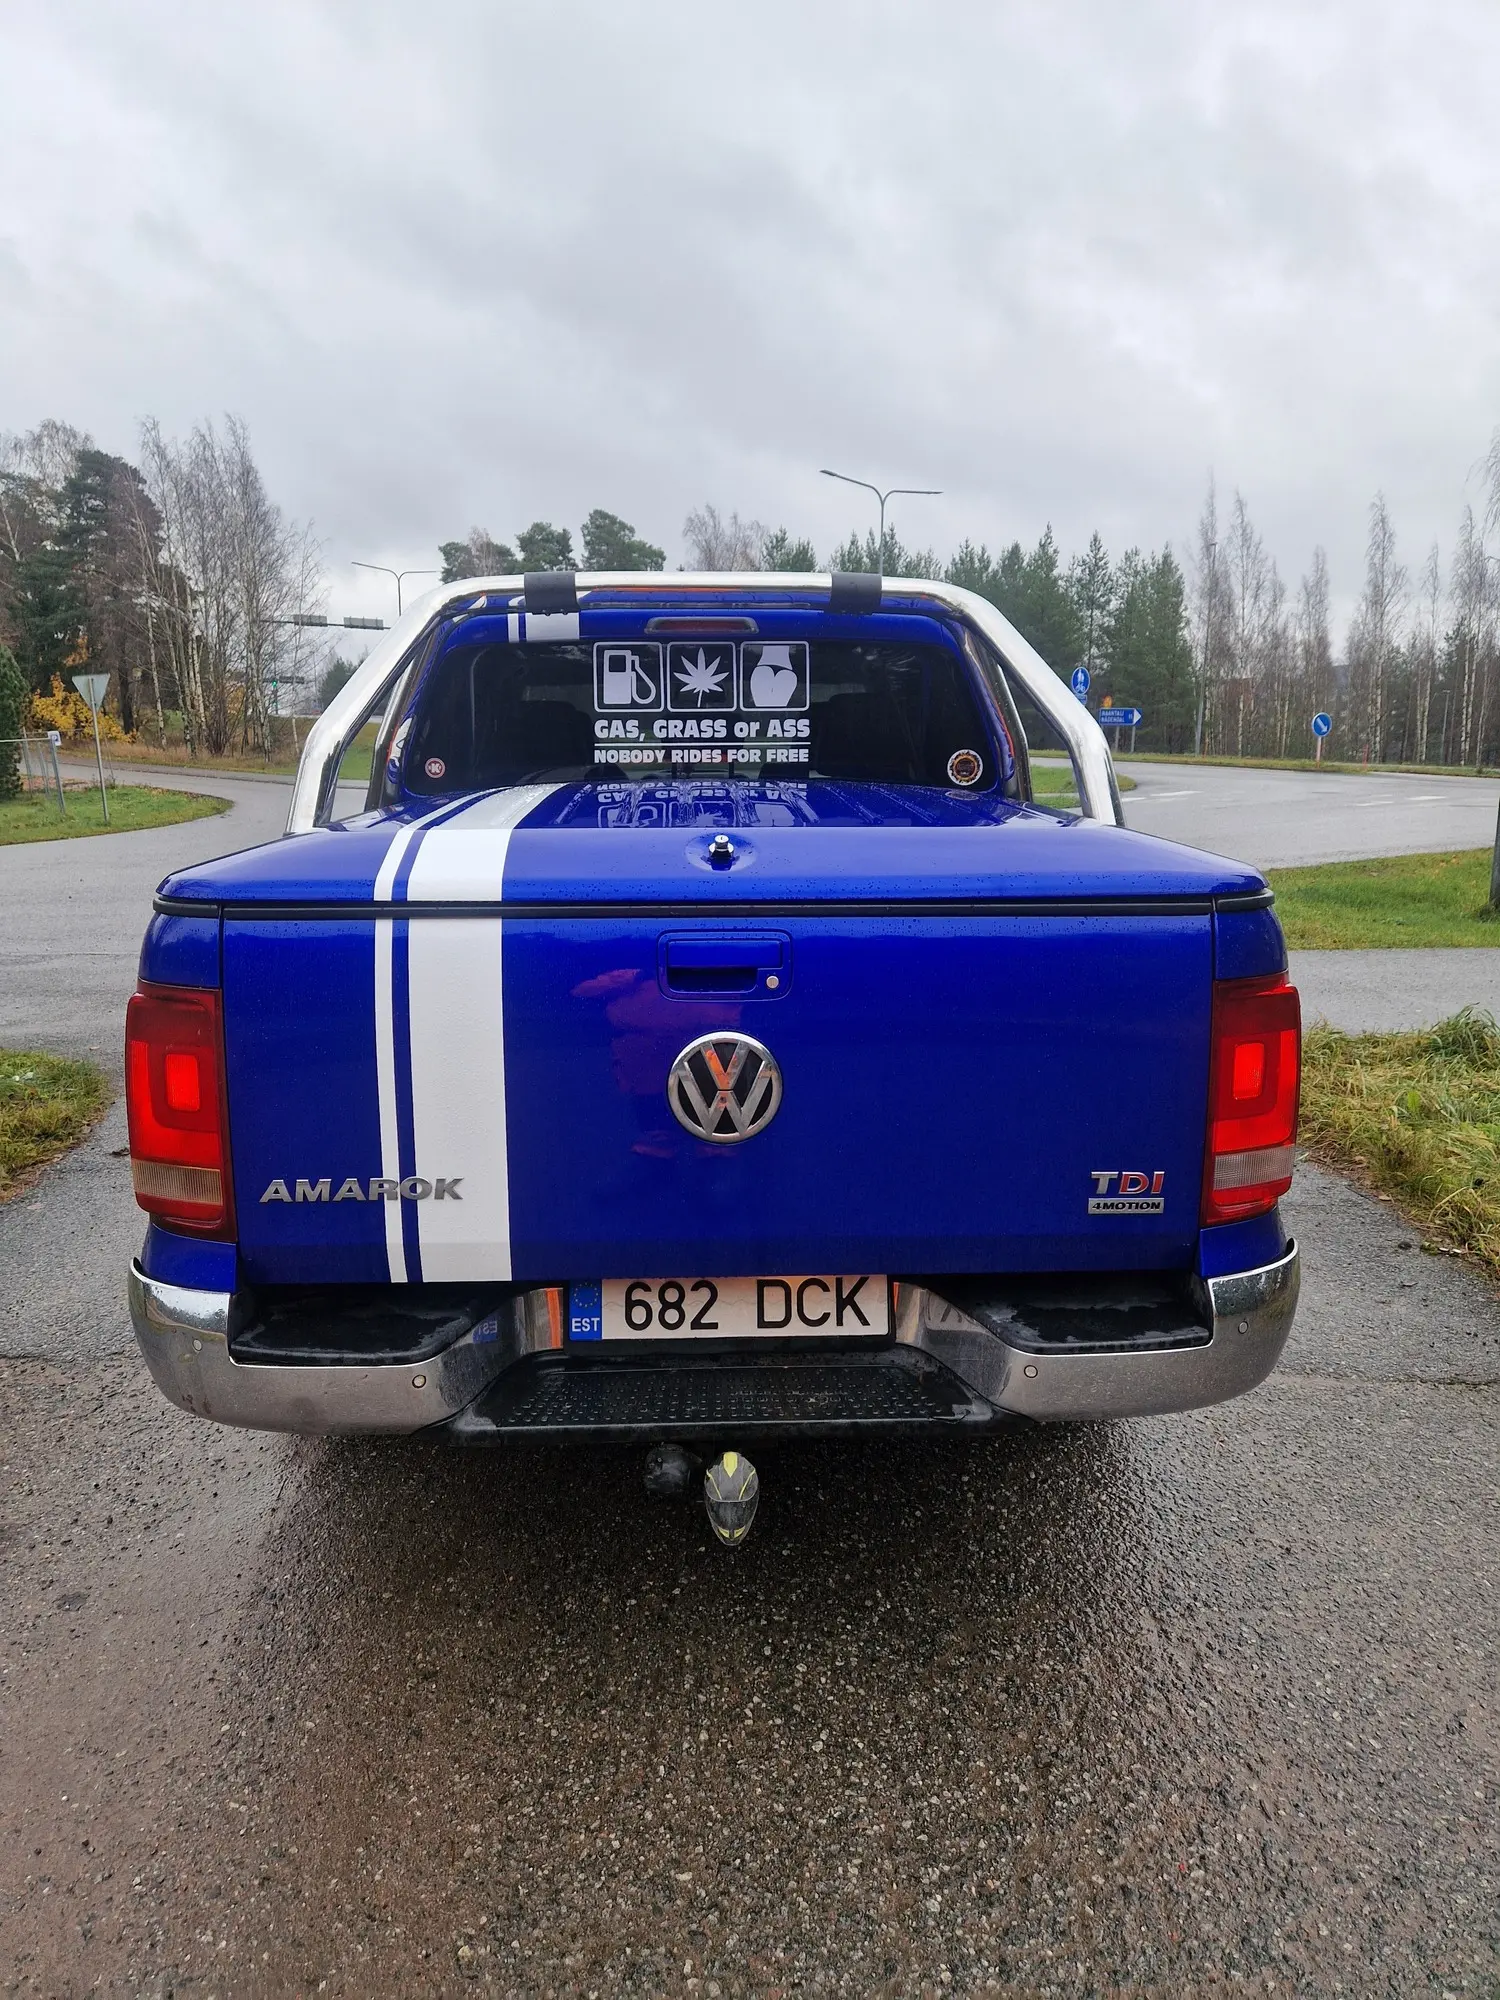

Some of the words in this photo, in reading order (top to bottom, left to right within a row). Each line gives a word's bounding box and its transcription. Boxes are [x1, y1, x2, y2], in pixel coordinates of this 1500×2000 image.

[594, 719, 646, 742] GAS,
[653, 719, 727, 738] GRASS
[734, 721, 760, 738] or
[767, 719, 810, 738] ASS
[594, 749, 666, 764] NOBODY
[671, 749, 722, 763] RIDES
[727, 749, 761, 763] FOR
[767, 748, 809, 763] FREE
[258, 1176, 465, 1203] AMAROK
[1091, 1171, 1165, 1194] TDI
[1092, 1201, 1161, 1210] 4MOTION
[624, 1280, 719, 1331] 682
[756, 1276, 871, 1329] DCK
[571, 1316, 600, 1333] EST
